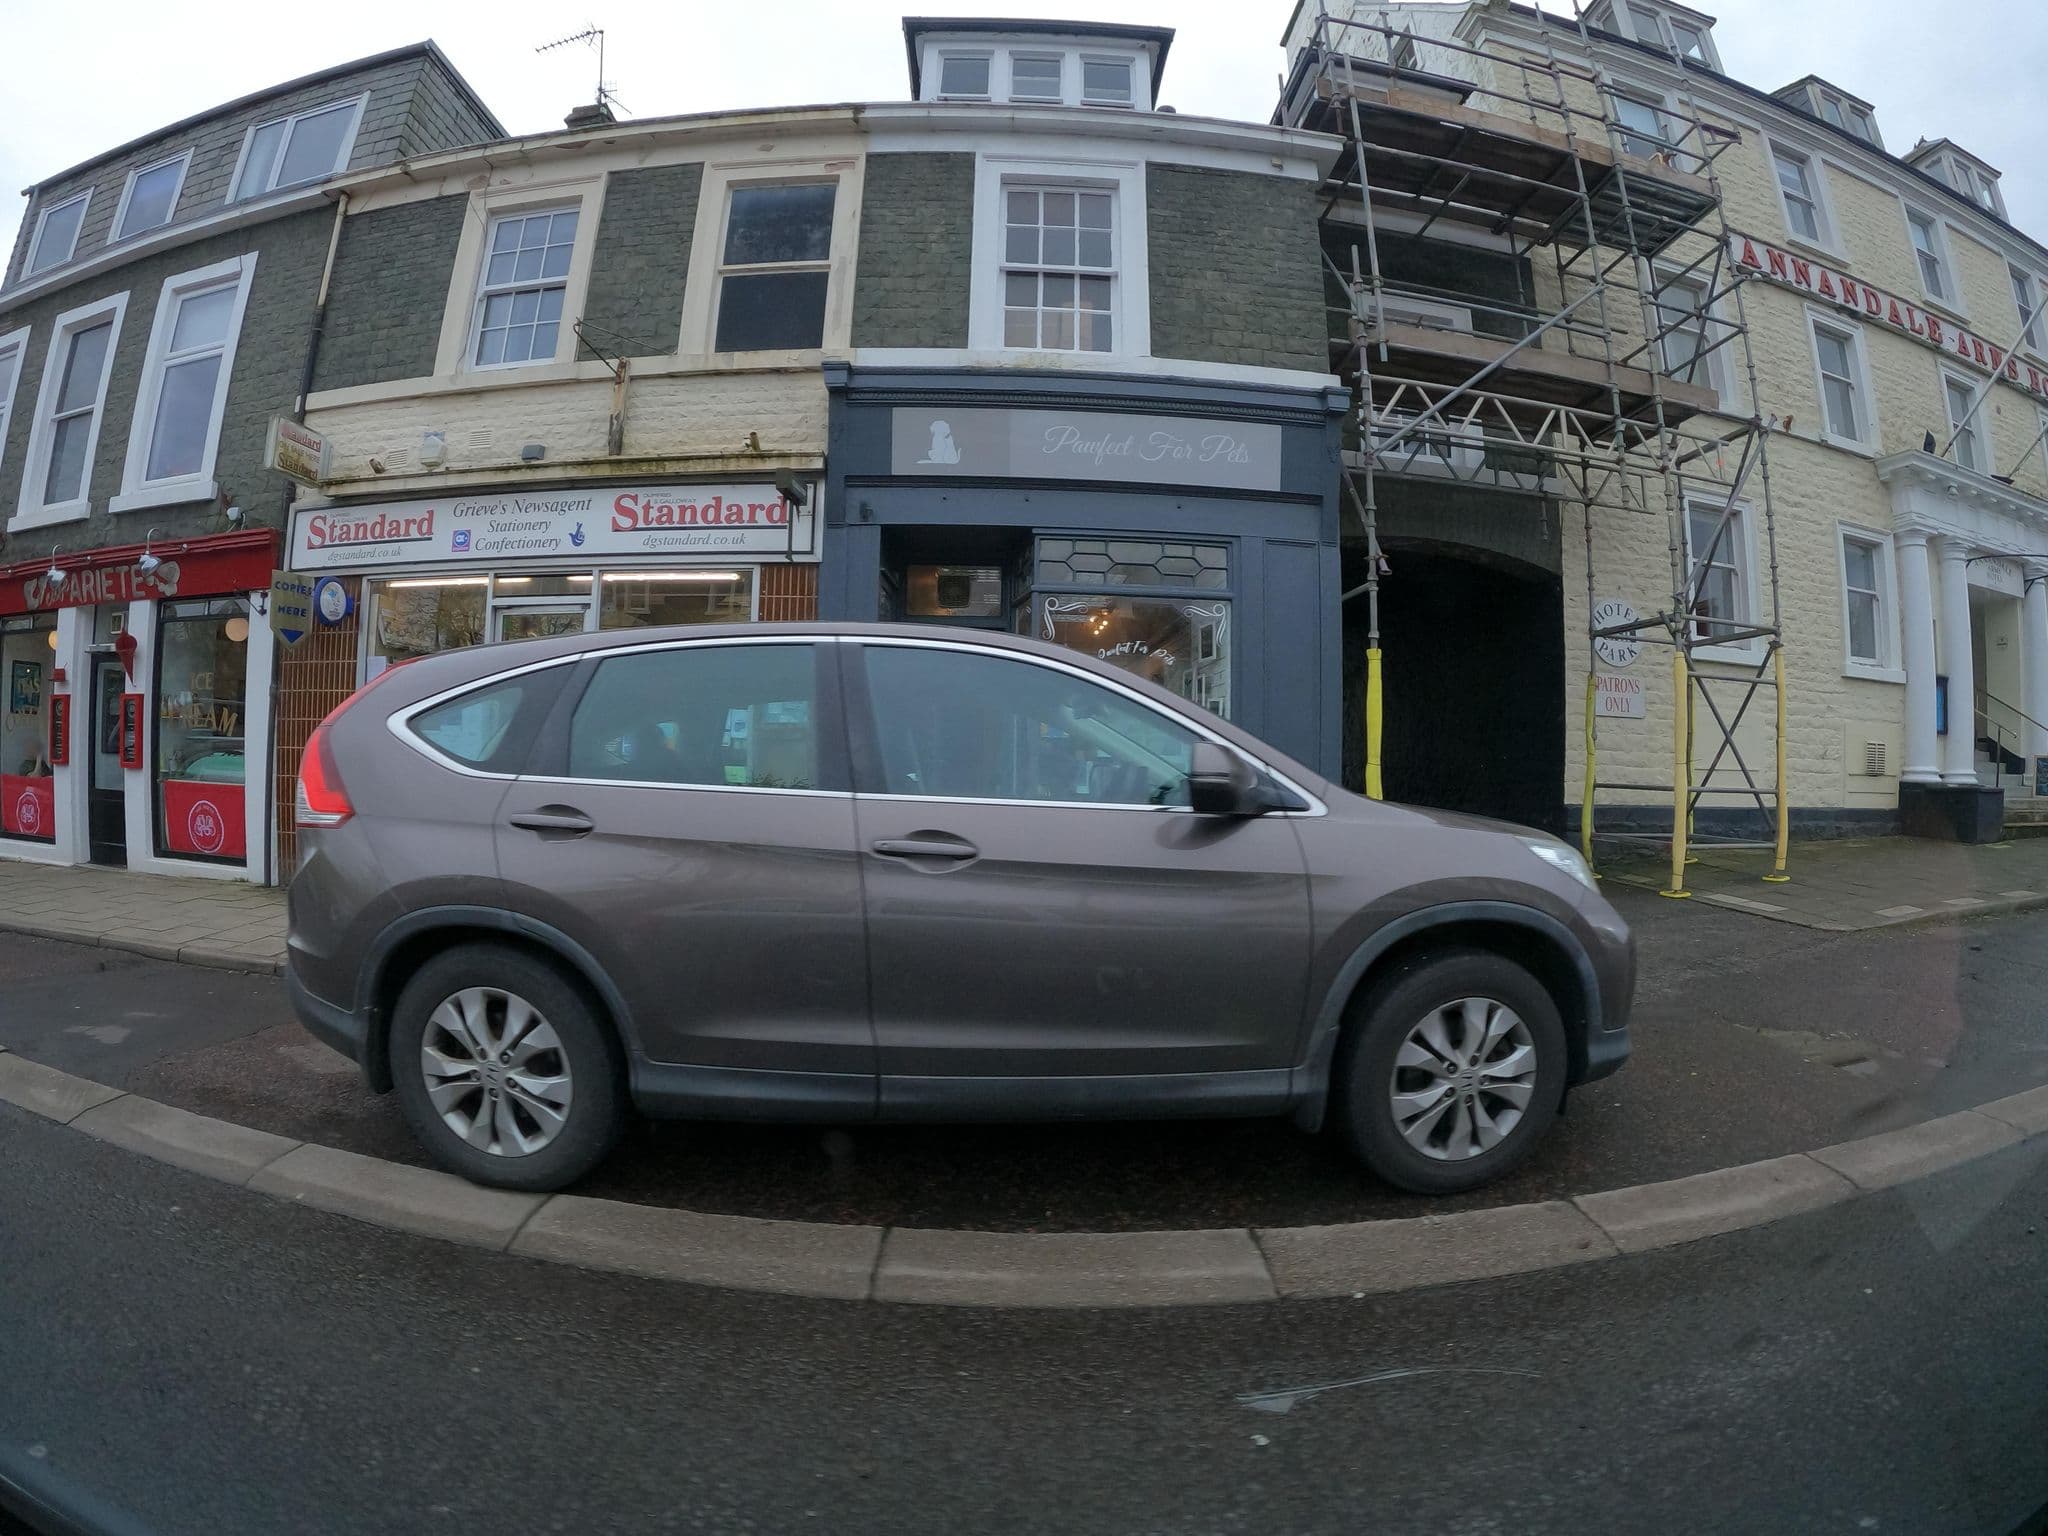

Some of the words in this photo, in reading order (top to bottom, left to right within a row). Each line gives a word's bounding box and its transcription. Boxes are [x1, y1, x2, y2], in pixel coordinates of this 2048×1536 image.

[1741, 239, 1943, 345] ANNANDALE
[1958, 331, 2019, 380] ARMS
[1042, 425, 1134, 465] Pawfect
[1139, 431, 1193, 461] For
[1199, 434, 1250, 464] Pets
[453, 499, 508, 517] Grieve's
[511, 498, 593, 516] Newsagent
[611, 493, 790, 532] Standard
[307, 510, 434, 550] Standard
[488, 519, 552, 533] Stationery
[475, 536, 562, 552] Confectionery
[642, 532, 748, 549] dgstandard.co.uk
[327, 547, 402, 562] dgstandard.co.uk
[278, 605, 307, 618] HERE
[1599, 641, 1638, 663] PARK
[1597, 676, 1640, 694] PATRONS
[1605, 697, 1631, 713] ONLY
